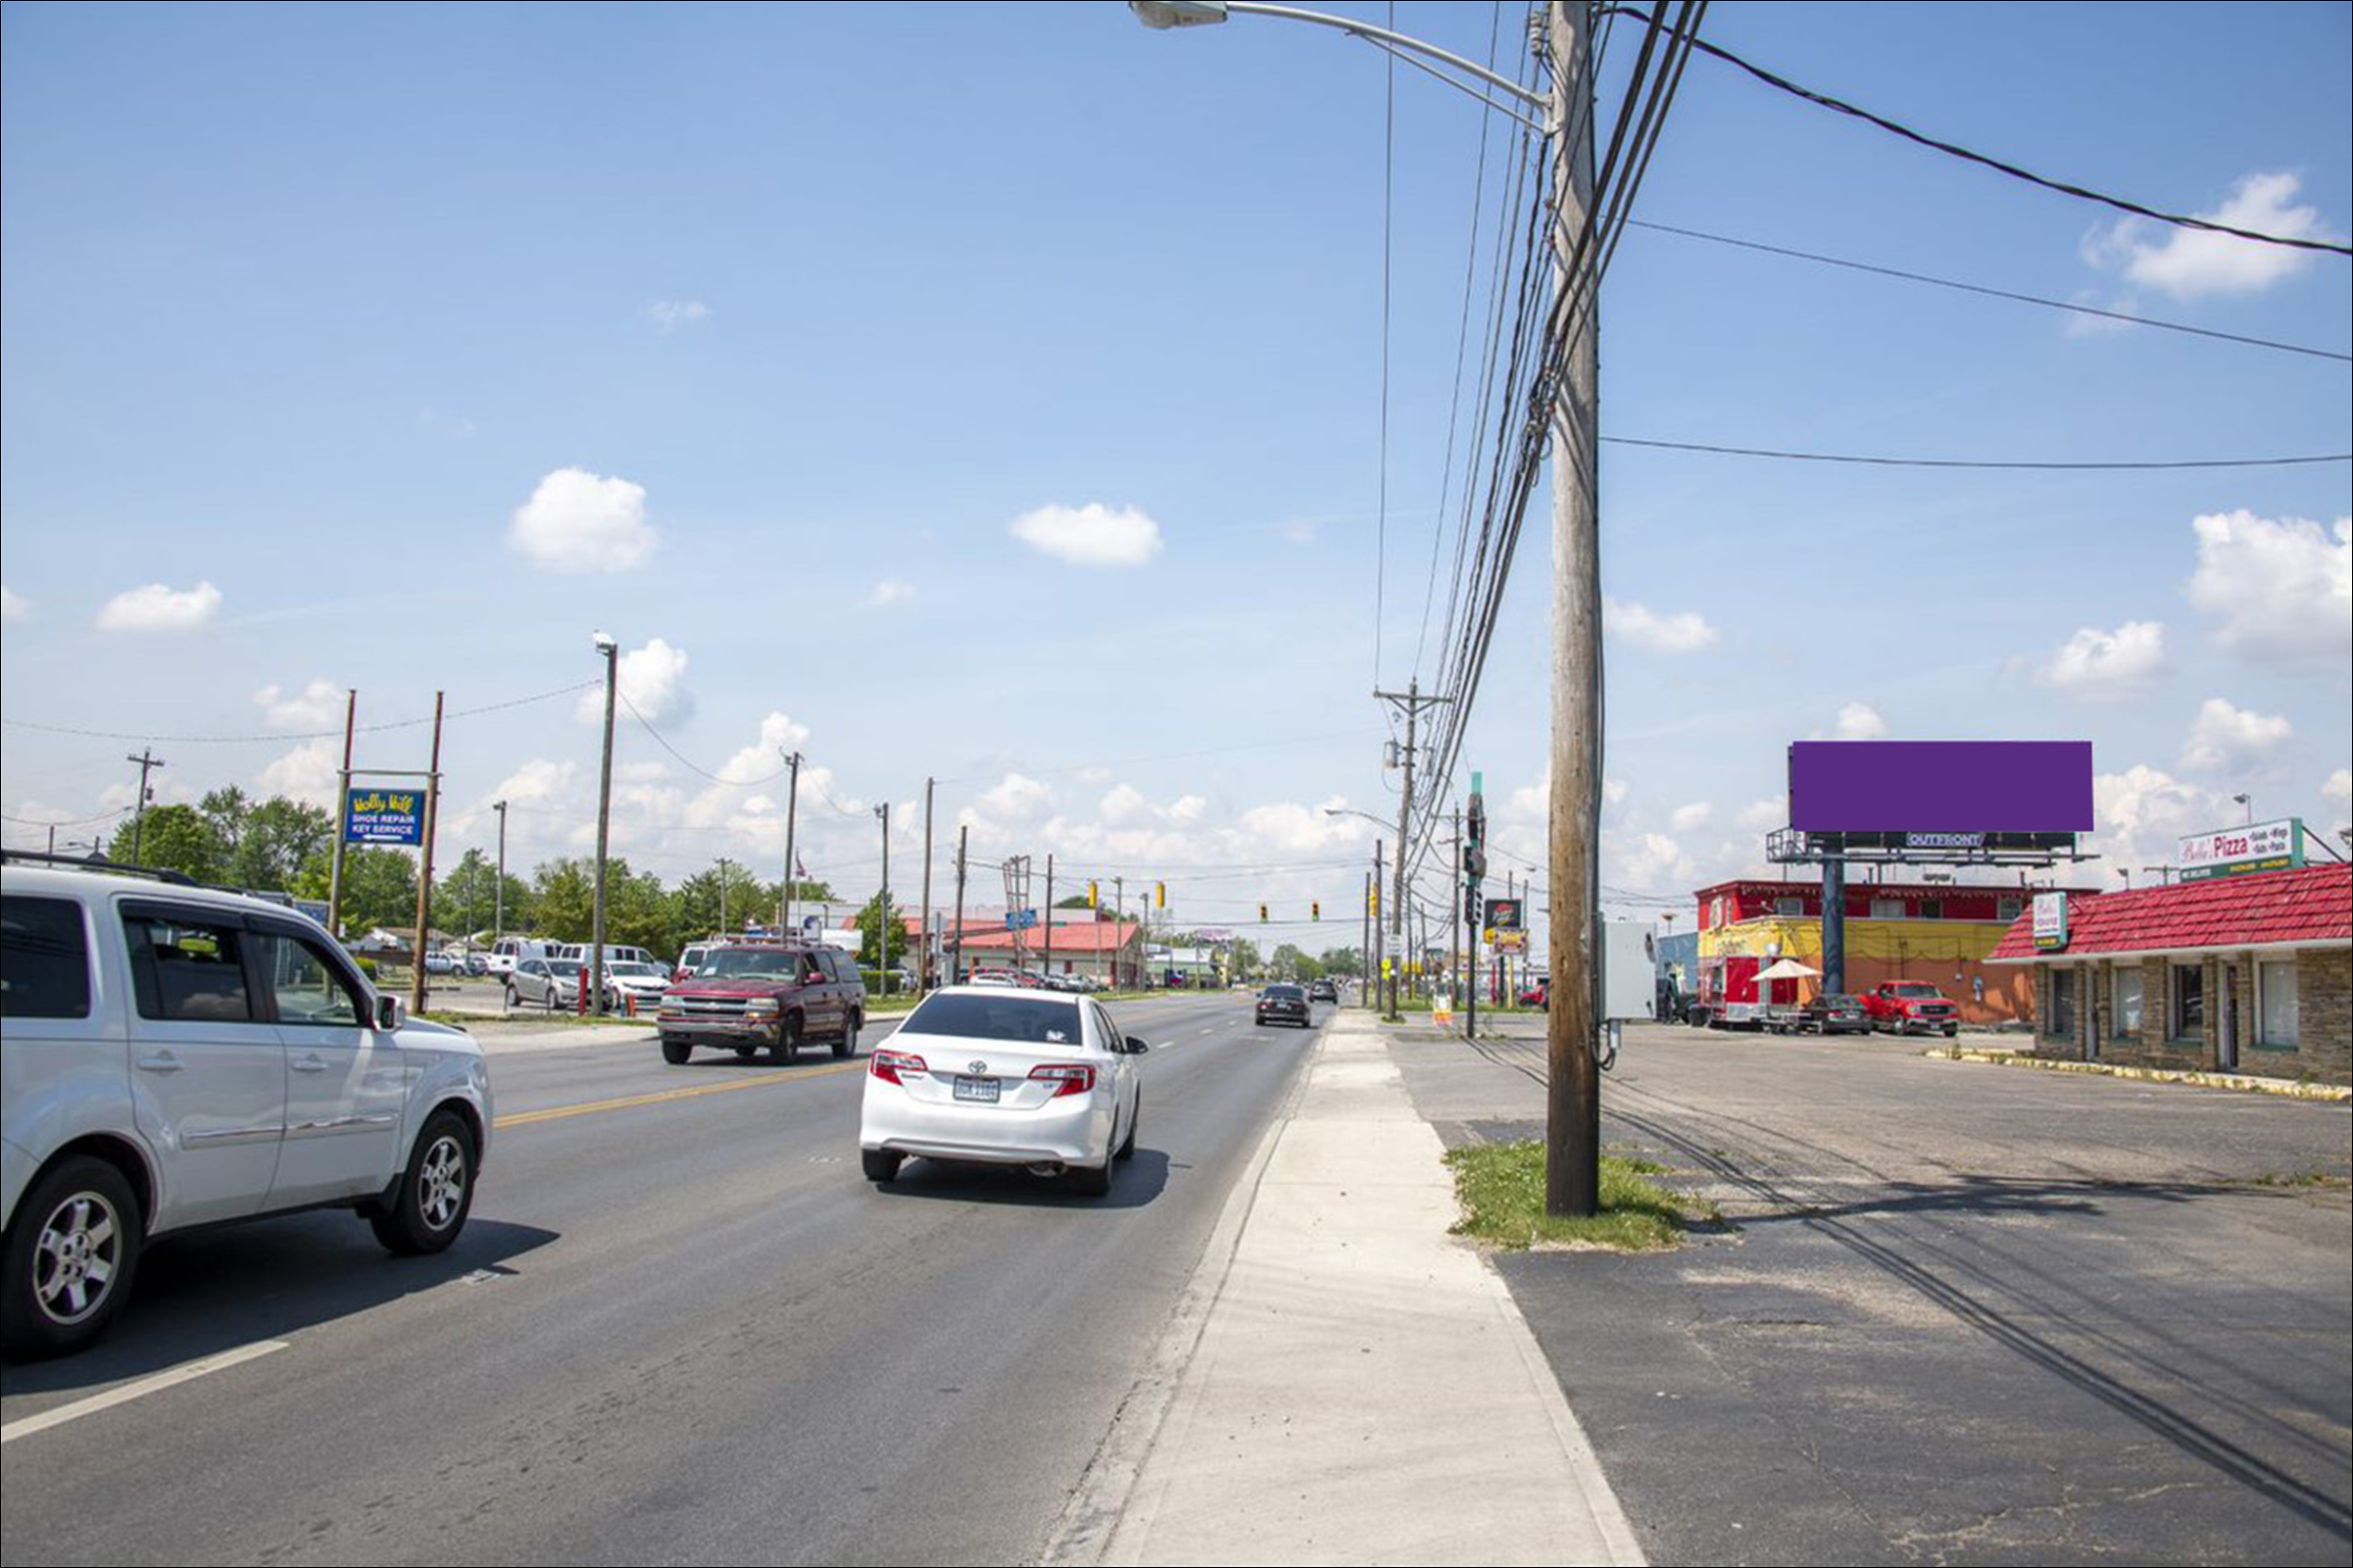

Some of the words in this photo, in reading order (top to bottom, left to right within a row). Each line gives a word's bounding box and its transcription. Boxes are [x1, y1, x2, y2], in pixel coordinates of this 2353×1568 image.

[354, 794, 385, 812] Holly
[389, 794, 414, 814] Hill
[353, 814, 377, 823] SHOE
[380, 814, 416, 823] REPAIR
[353, 824, 370, 833] KEY
[372, 824, 414, 834] SERVICE
[1909, 834, 1982, 844] OUTFRONT
[2215, 836, 2248, 858] Pizza
